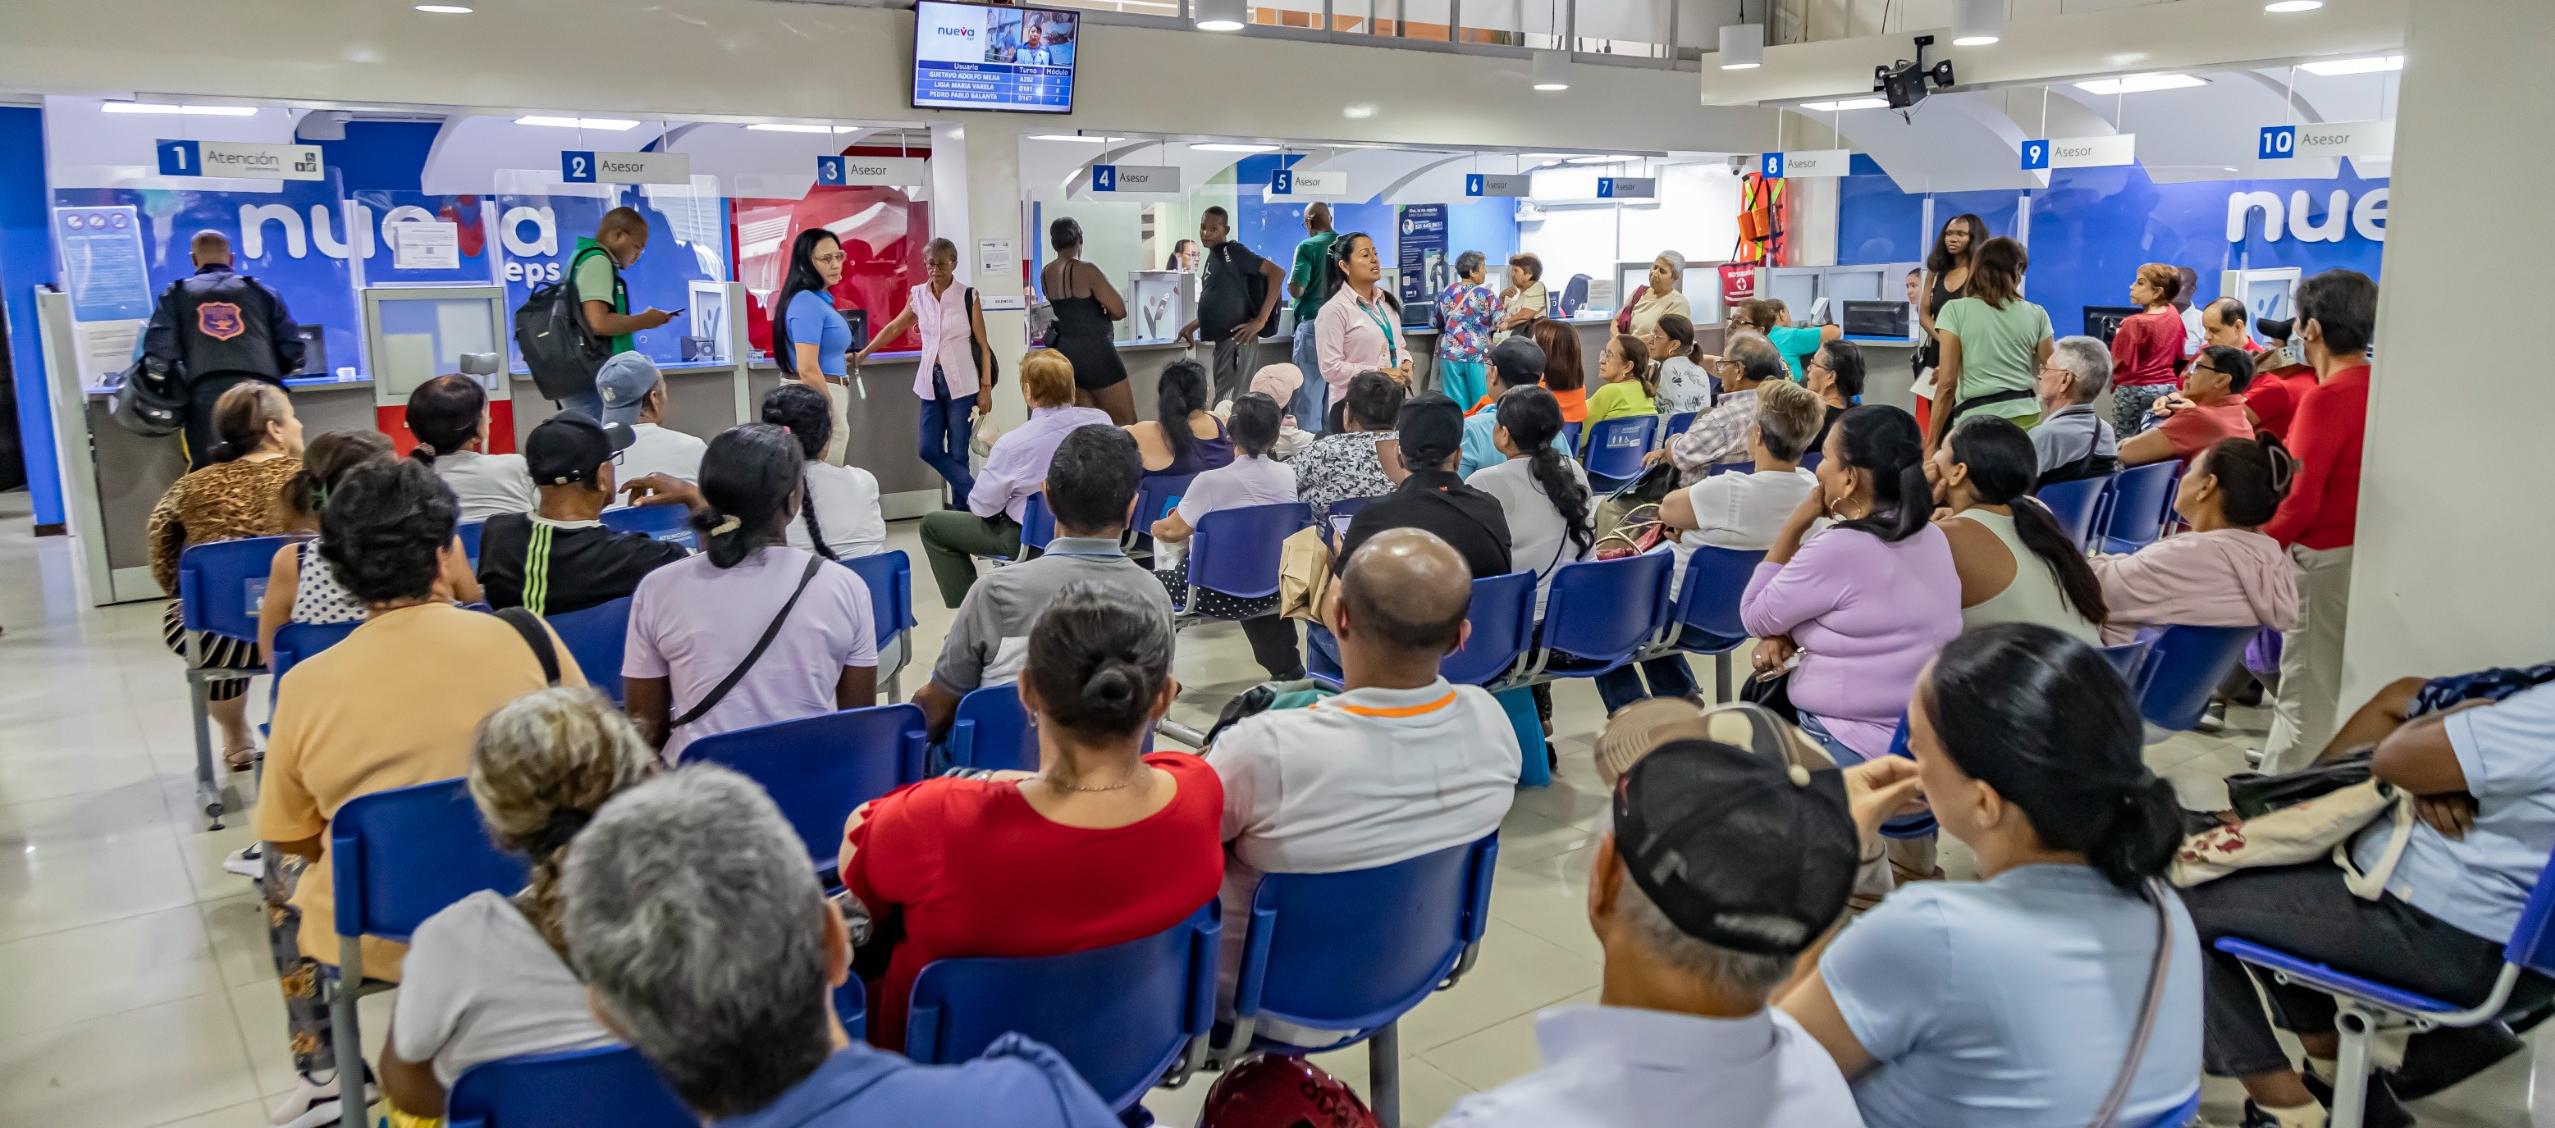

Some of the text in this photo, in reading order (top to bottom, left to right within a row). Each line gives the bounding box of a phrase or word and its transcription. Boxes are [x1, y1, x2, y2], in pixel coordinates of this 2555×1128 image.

[938, 26, 975, 36] nueva
[2264, 131, 2350, 153] 10 Asesor
[173, 146, 280, 170] 1 Atención
[2028, 145, 2092, 165] 9 Asesor
[571, 157, 645, 178] 2 Asesor
[825, 161, 888, 181] 3 Asesor
[1767, 157, 1817, 174] 8 Asesor
[1099, 170, 1150, 187] 4 Asesor
[1277, 174, 1321, 190] 5 Asesor
[1471, 177, 1508, 193] 6 Asesor
[1601, 181, 1609, 195] 7
[504, 262, 560, 288] eps
